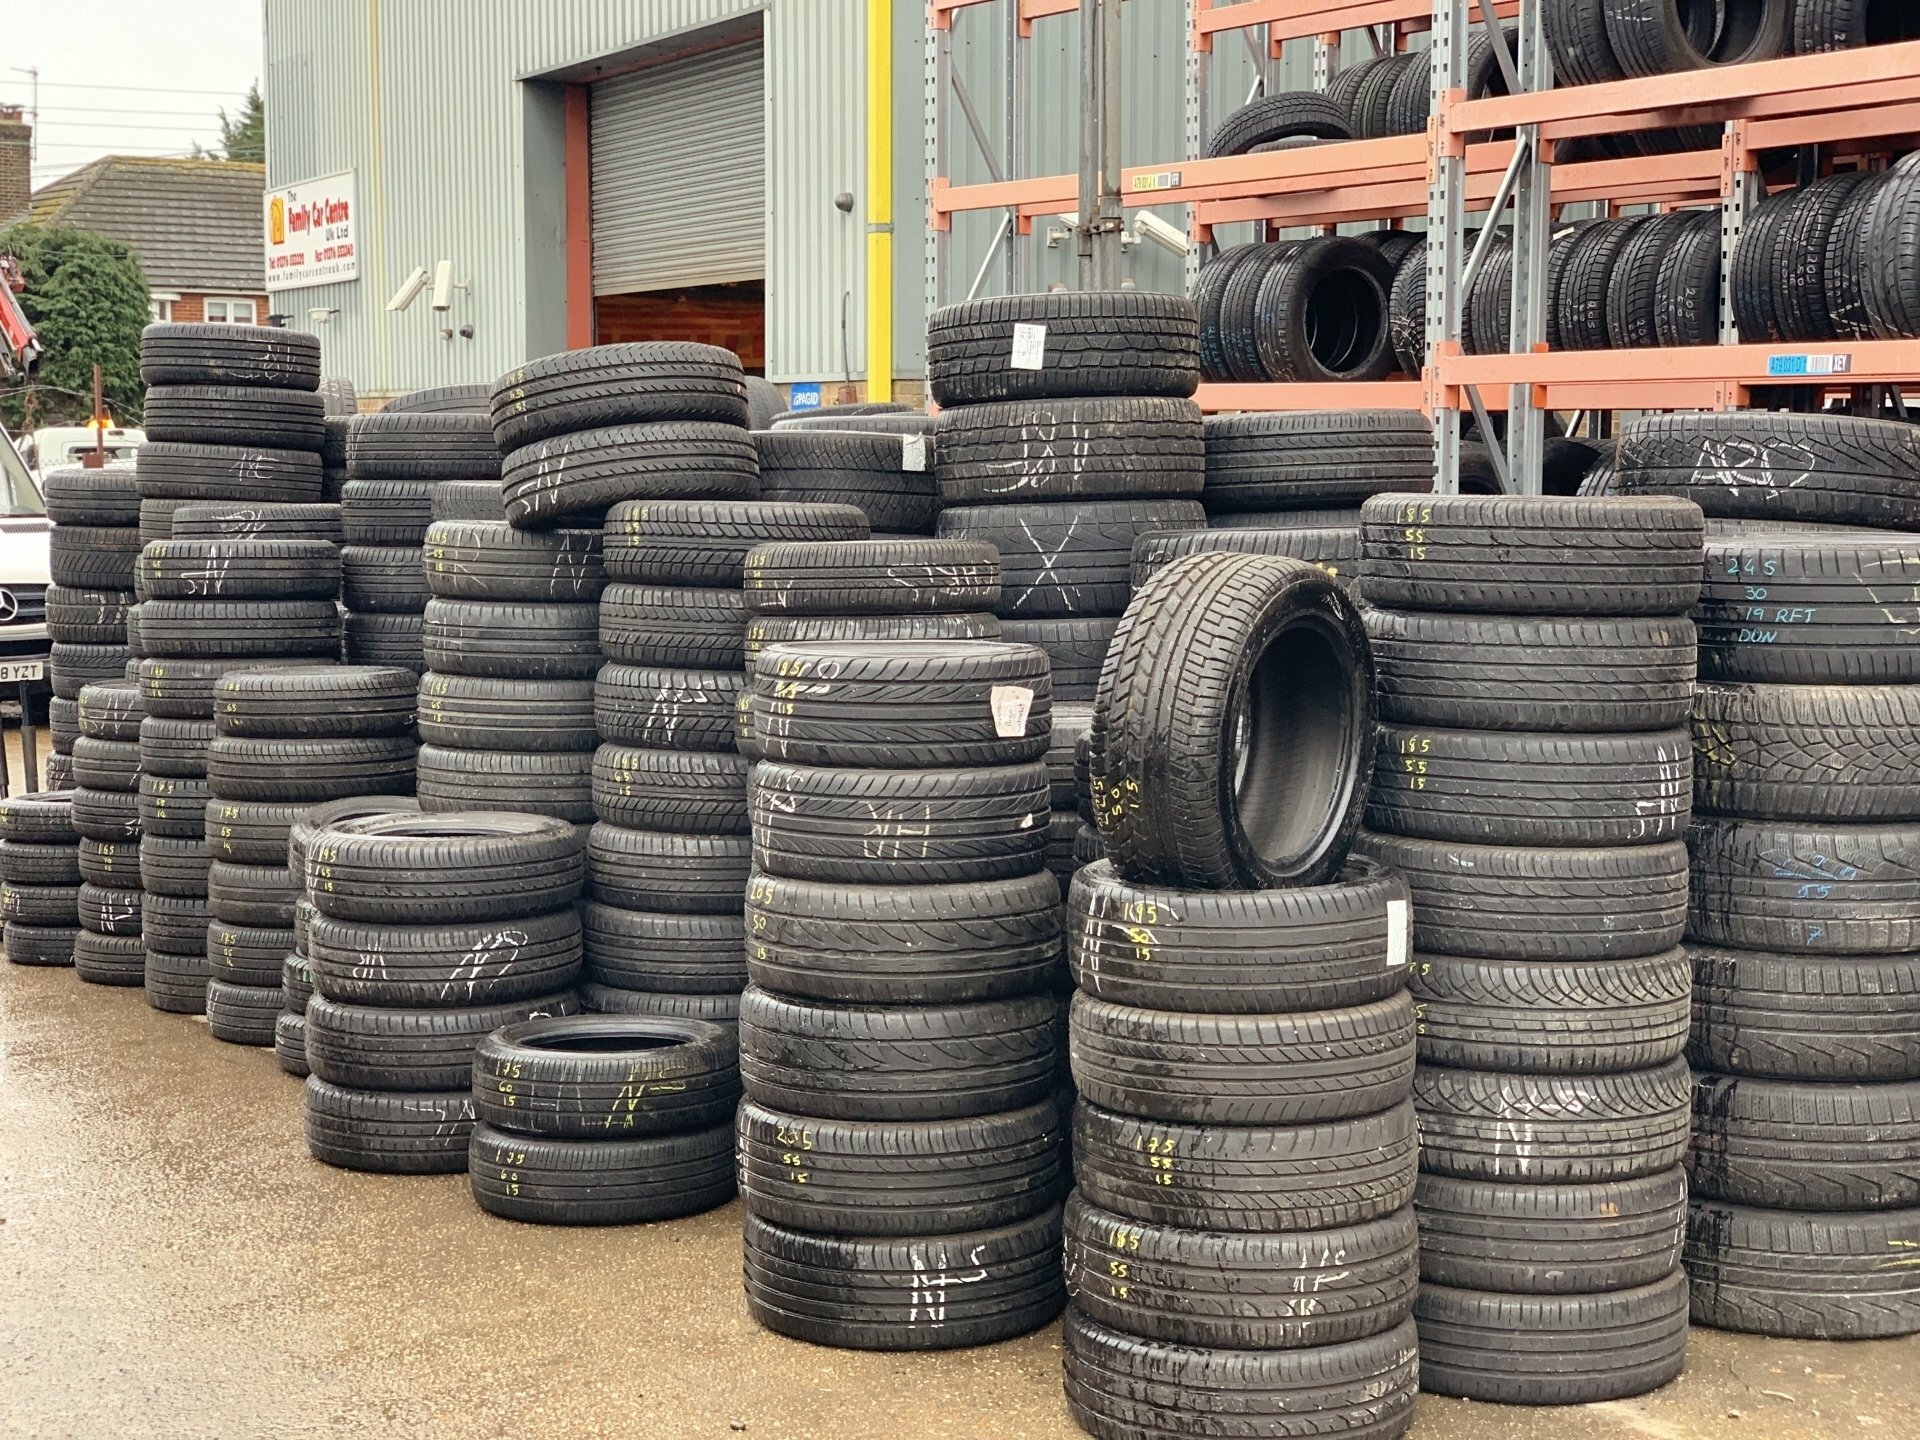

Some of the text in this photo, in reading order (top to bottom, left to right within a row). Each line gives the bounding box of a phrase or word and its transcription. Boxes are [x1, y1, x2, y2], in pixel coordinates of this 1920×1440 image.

[288, 191, 297, 203] The
[288, 197, 349, 235] Family Car Centre
[336, 225, 349, 239] Ltd
[1397, 508, 1431, 524] 185
[1405, 529, 1426, 543] 55
[1410, 547, 1426, 560] 15
[1745, 586, 1767, 600] 30
[1745, 607, 1816, 623] 19 RFT
[1738, 628, 1778, 644] DUN
[13, 664, 38, 679] YZT
[430, 683, 448, 695] 195
[1401, 738, 1431, 754] 185
[613, 756, 638, 770] 195
[614, 771, 630, 782] 65
[220, 806, 239, 819] 175
[98, 843, 115, 855] 165
[1130, 927, 1150, 944] 50
[495, 1058, 522, 1078] 175
[1136, 1135, 1175, 1153] 175
[783, 1153, 801, 1166] 55
[1150, 1156, 1173, 1170] 55
[791, 1172, 808, 1184] 15
[1155, 1173, 1172, 1185] 15
[1109, 1230, 1139, 1250] 185
[1109, 1261, 1127, 1278] 55
[1111, 1286, 1127, 1299] 15
